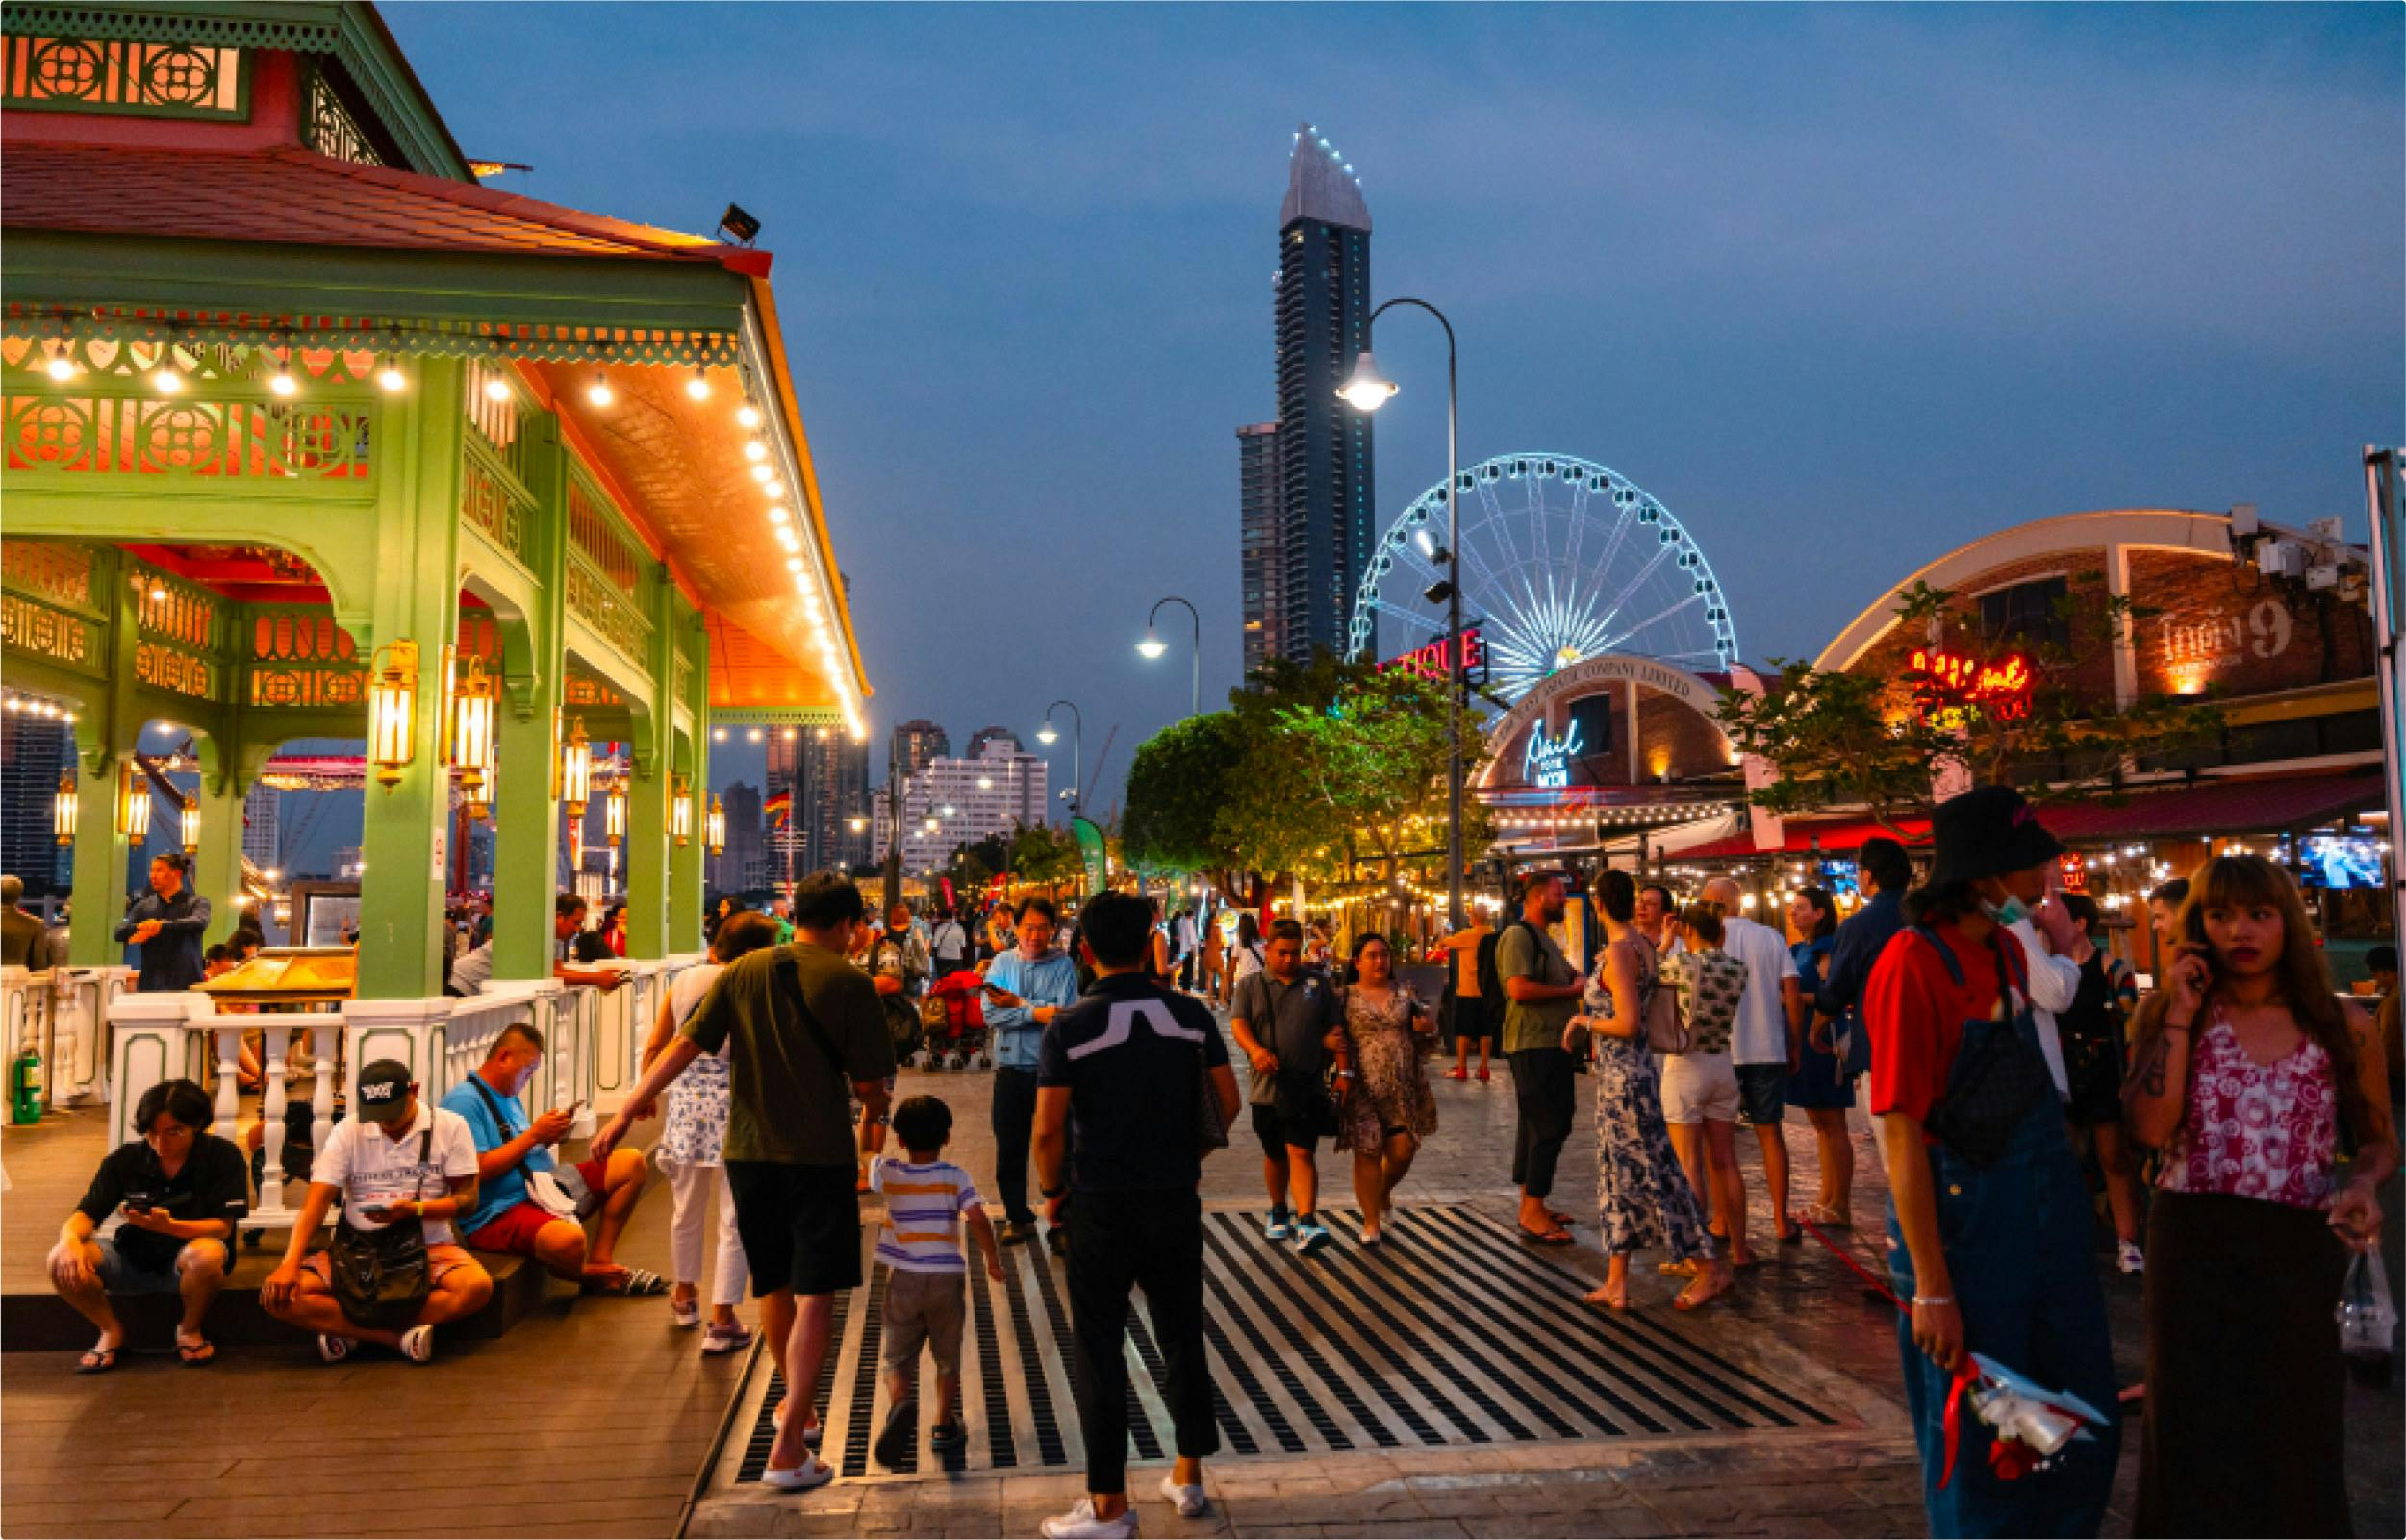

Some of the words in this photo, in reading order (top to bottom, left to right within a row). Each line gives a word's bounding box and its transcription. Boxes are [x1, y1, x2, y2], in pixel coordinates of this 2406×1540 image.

[2249, 600, 2292, 658] 9
[1584, 661, 1634, 678] COMPANY
[1642, 664, 1691, 696] LIMITED
